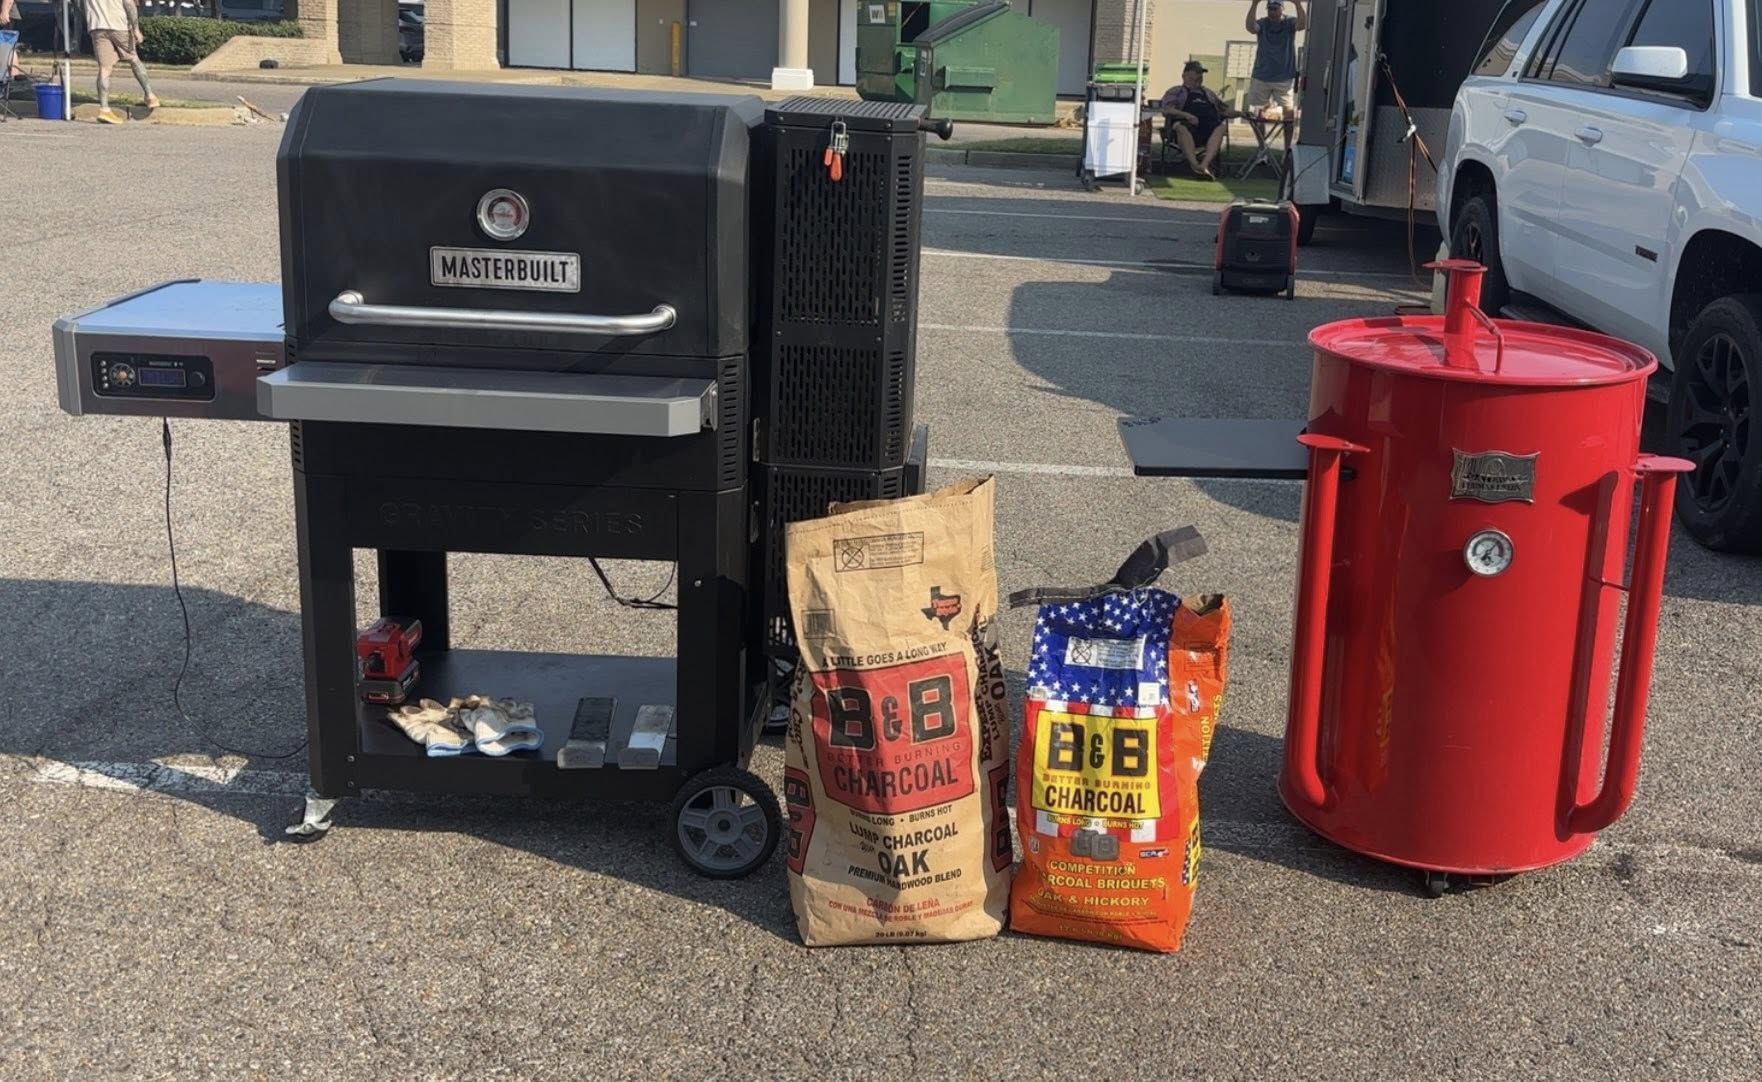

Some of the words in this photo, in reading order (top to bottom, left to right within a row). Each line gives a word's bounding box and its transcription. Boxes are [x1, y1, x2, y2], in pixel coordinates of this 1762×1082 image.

[441, 255, 569, 284] MASTERBUILT
[831, 654, 865, 668] LITTLE
[866, 652, 895, 666] GOES
[896, 650, 904, 662] A
[905, 647, 931, 661] LONG
[894, 742, 961, 765] BURNING
[833, 758, 959, 800] CHARCOAL
[1045, 785, 1146, 814] CHARCOAL
[871, 815, 896, 827] LONG
[908, 809, 936, 823] BURNS
[936, 804, 953, 818] HOT
[848, 821, 880, 845] LUMP
[882, 821, 959, 850] CHARCOAL
[878, 848, 931, 879] OAK
[1049, 860, 1136, 875] COMPETITION
[934, 867, 962, 884] BLEND
[1097, 876, 1166, 889] BRIQUETS
[902, 902, 915, 914] DE
[916, 898, 940, 911] LEÑA
[1069, 894, 1078, 904] &
[1084, 896, 1150, 906] HICKORY
